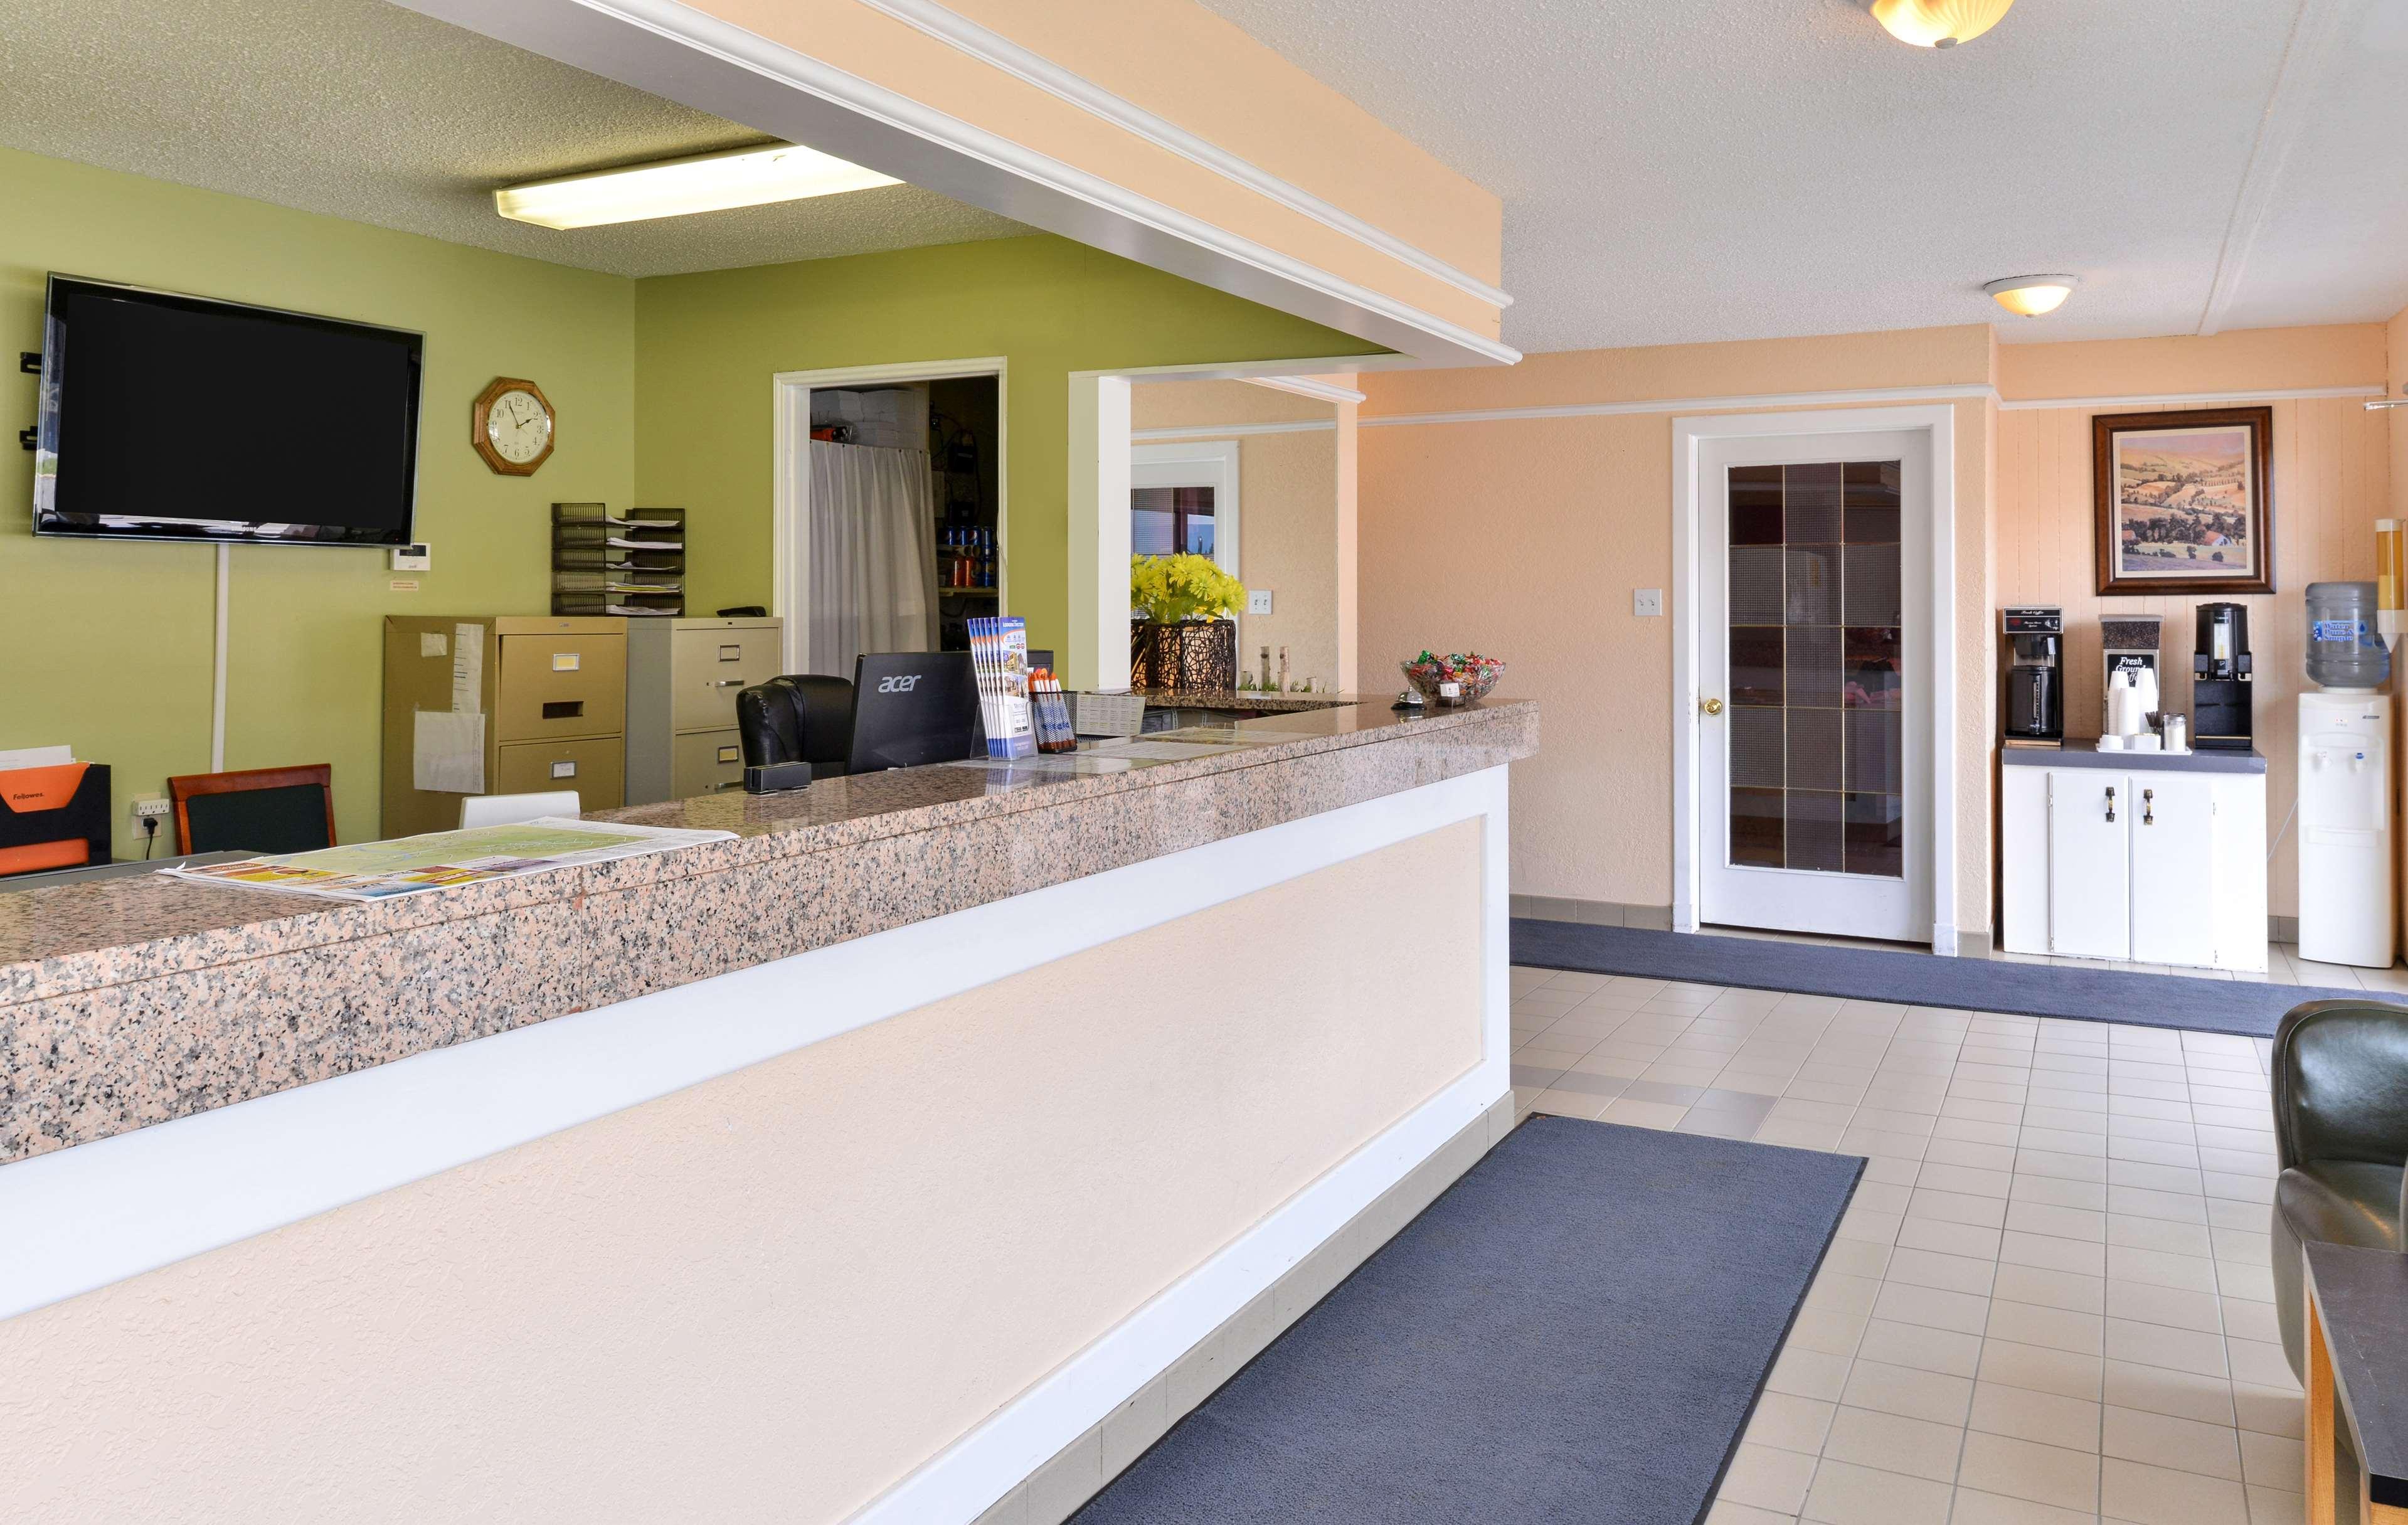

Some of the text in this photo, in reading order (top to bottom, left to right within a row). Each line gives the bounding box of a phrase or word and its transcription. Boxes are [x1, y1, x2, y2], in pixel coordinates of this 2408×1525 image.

[515, 397, 522, 406] 12
[496, 409, 504, 418] 10
[2119, 657, 2143, 665] Fresh
[878, 675, 922, 693] acer
